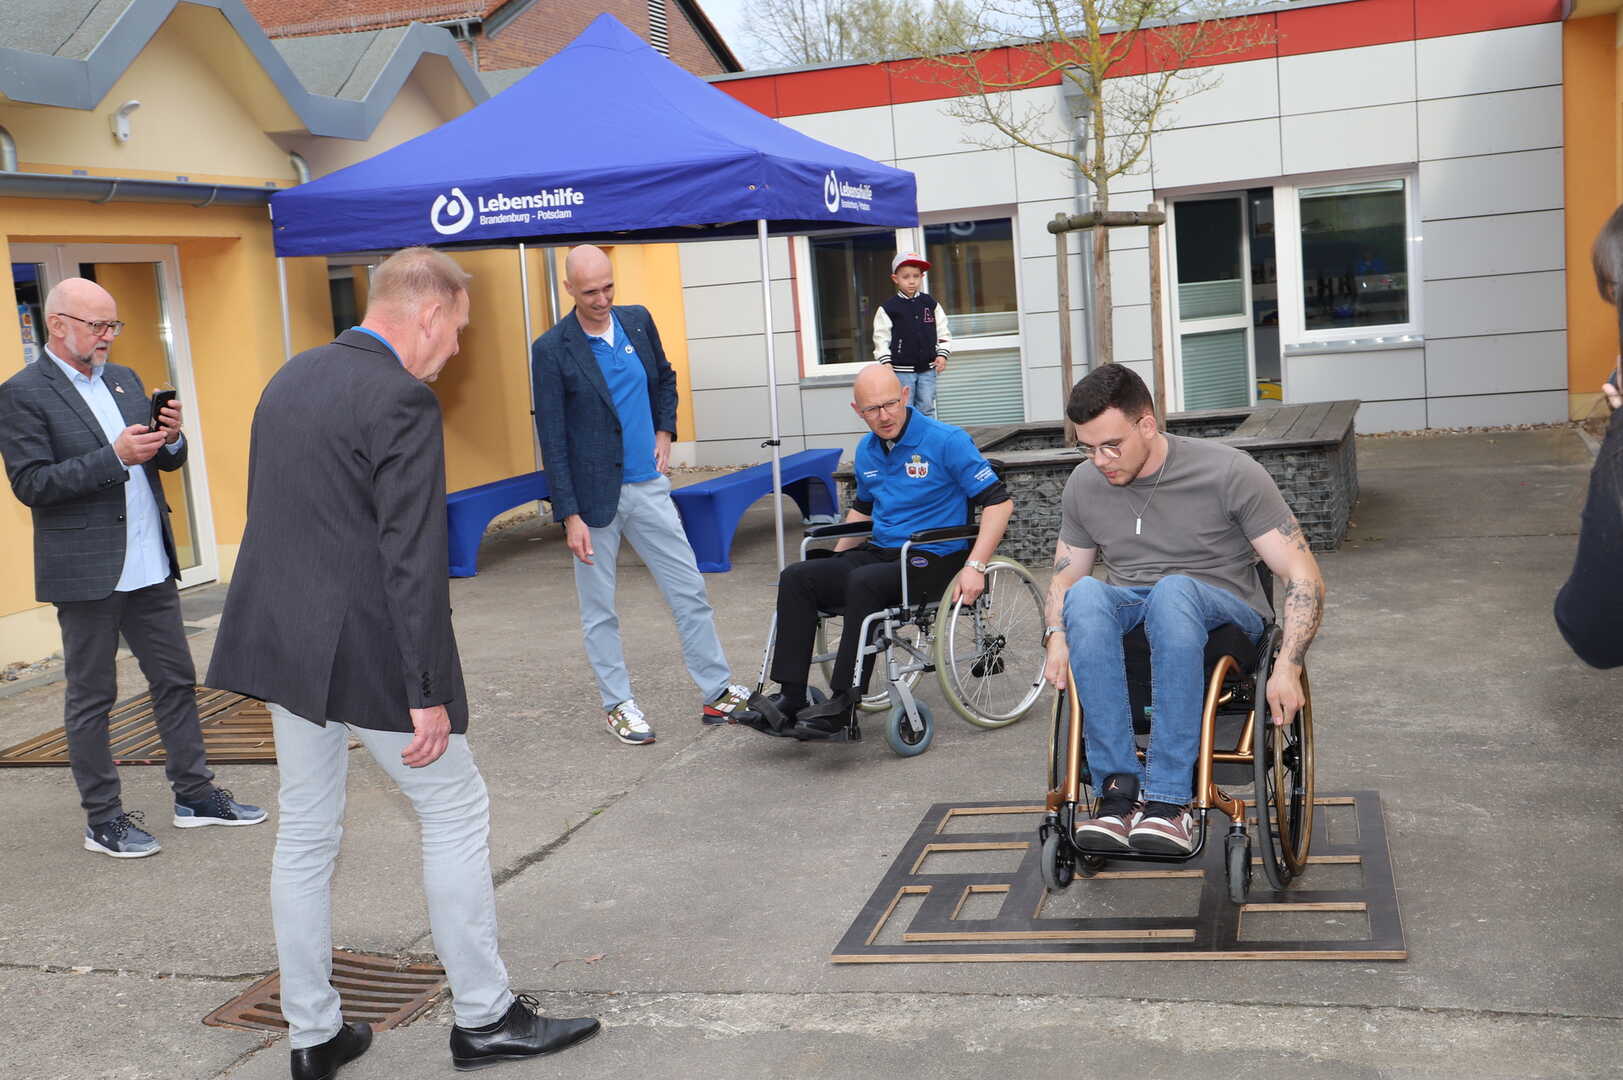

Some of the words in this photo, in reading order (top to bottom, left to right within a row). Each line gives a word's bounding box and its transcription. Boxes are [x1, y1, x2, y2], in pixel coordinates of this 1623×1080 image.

[478, 187, 584, 213] Lebenshilfe
[480, 212, 530, 226] Brandenburg
[537, 209, 571, 220] Potsdam
